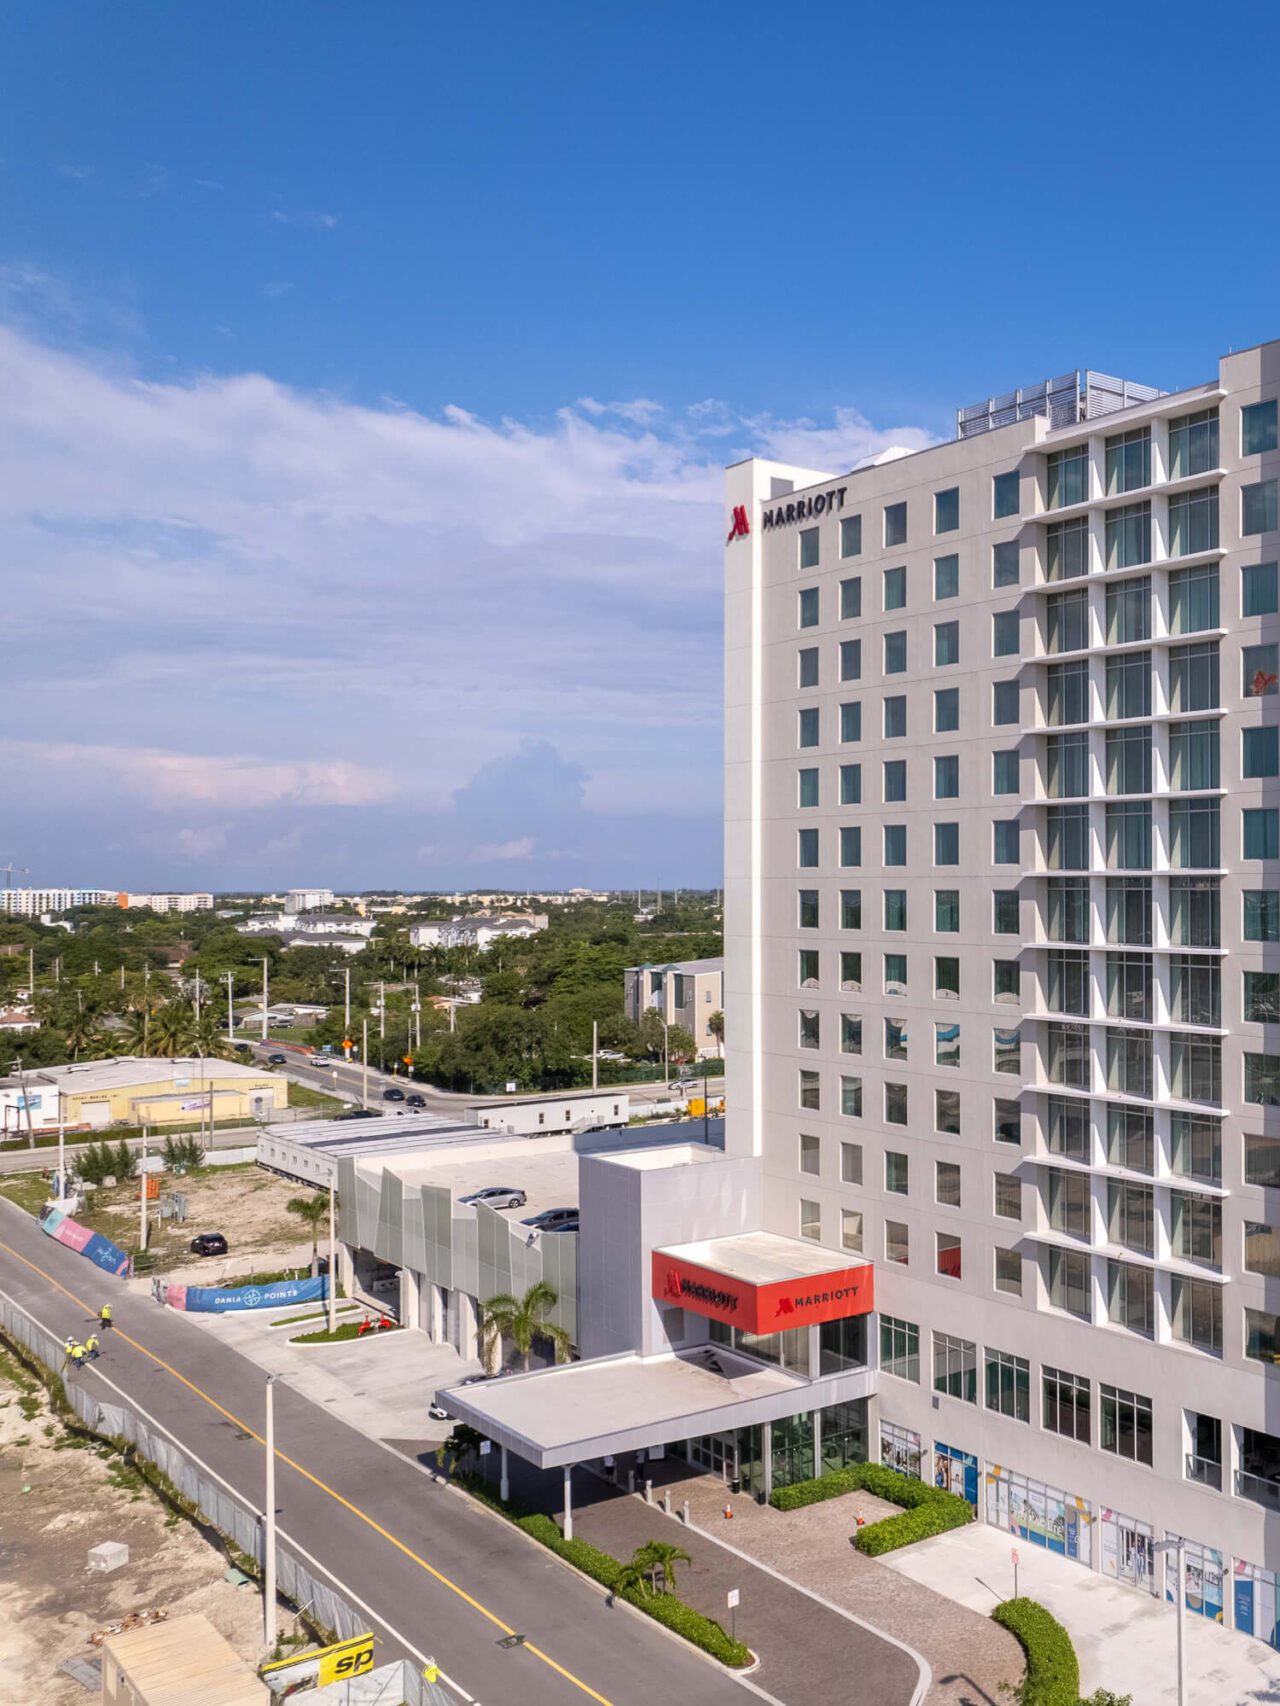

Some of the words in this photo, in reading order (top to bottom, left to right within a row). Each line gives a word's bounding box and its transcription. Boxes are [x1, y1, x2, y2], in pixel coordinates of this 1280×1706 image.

[763, 486, 848, 530] MARRIOTT
[264, 1290, 298, 1300] POINTE
[795, 1286, 859, 1308] MARRIOTT
